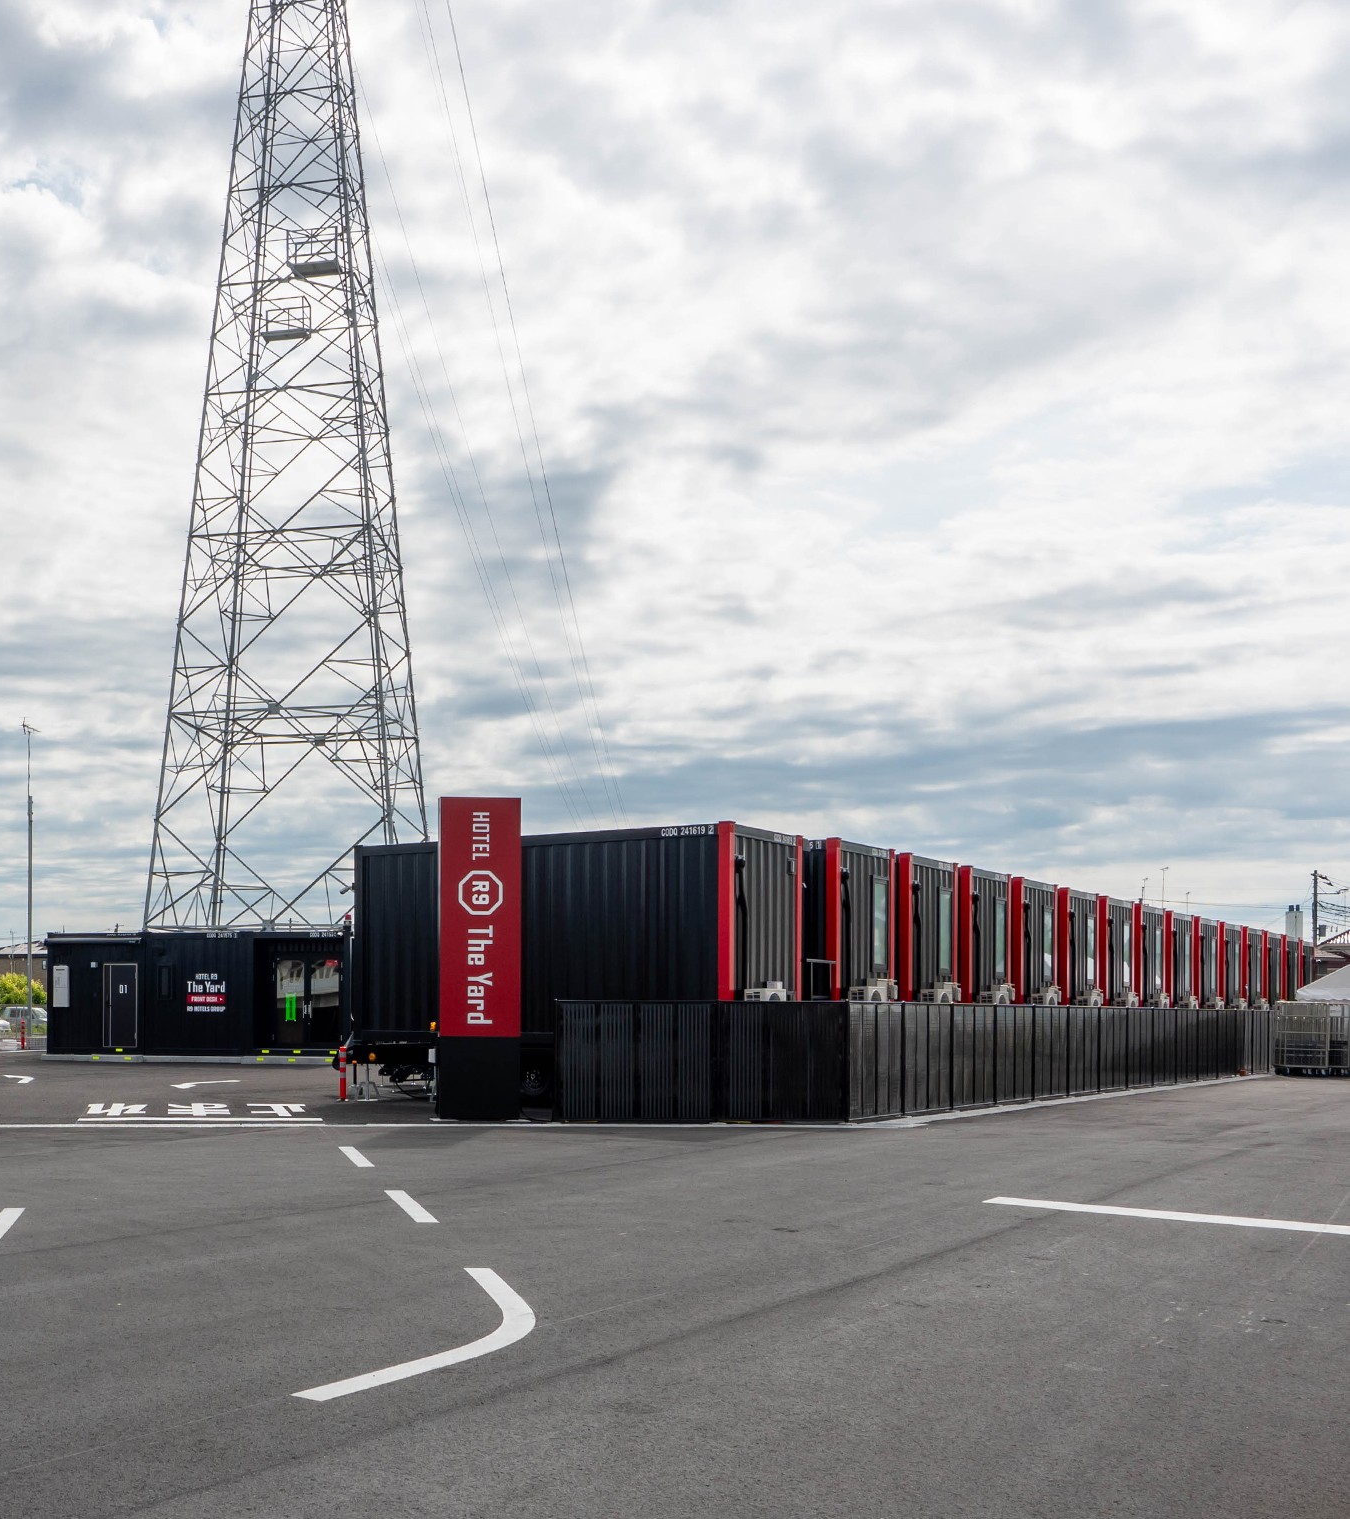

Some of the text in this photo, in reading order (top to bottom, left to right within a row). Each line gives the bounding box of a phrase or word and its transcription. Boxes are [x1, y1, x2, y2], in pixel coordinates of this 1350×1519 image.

[680, 824, 706, 836] 241619
[708, 824, 715, 835] 2
[467, 811, 493, 1025] HOTEL R9 The Yard
[119, 984, 128, 994] 01
[187, 981, 226, 993] The Yard
